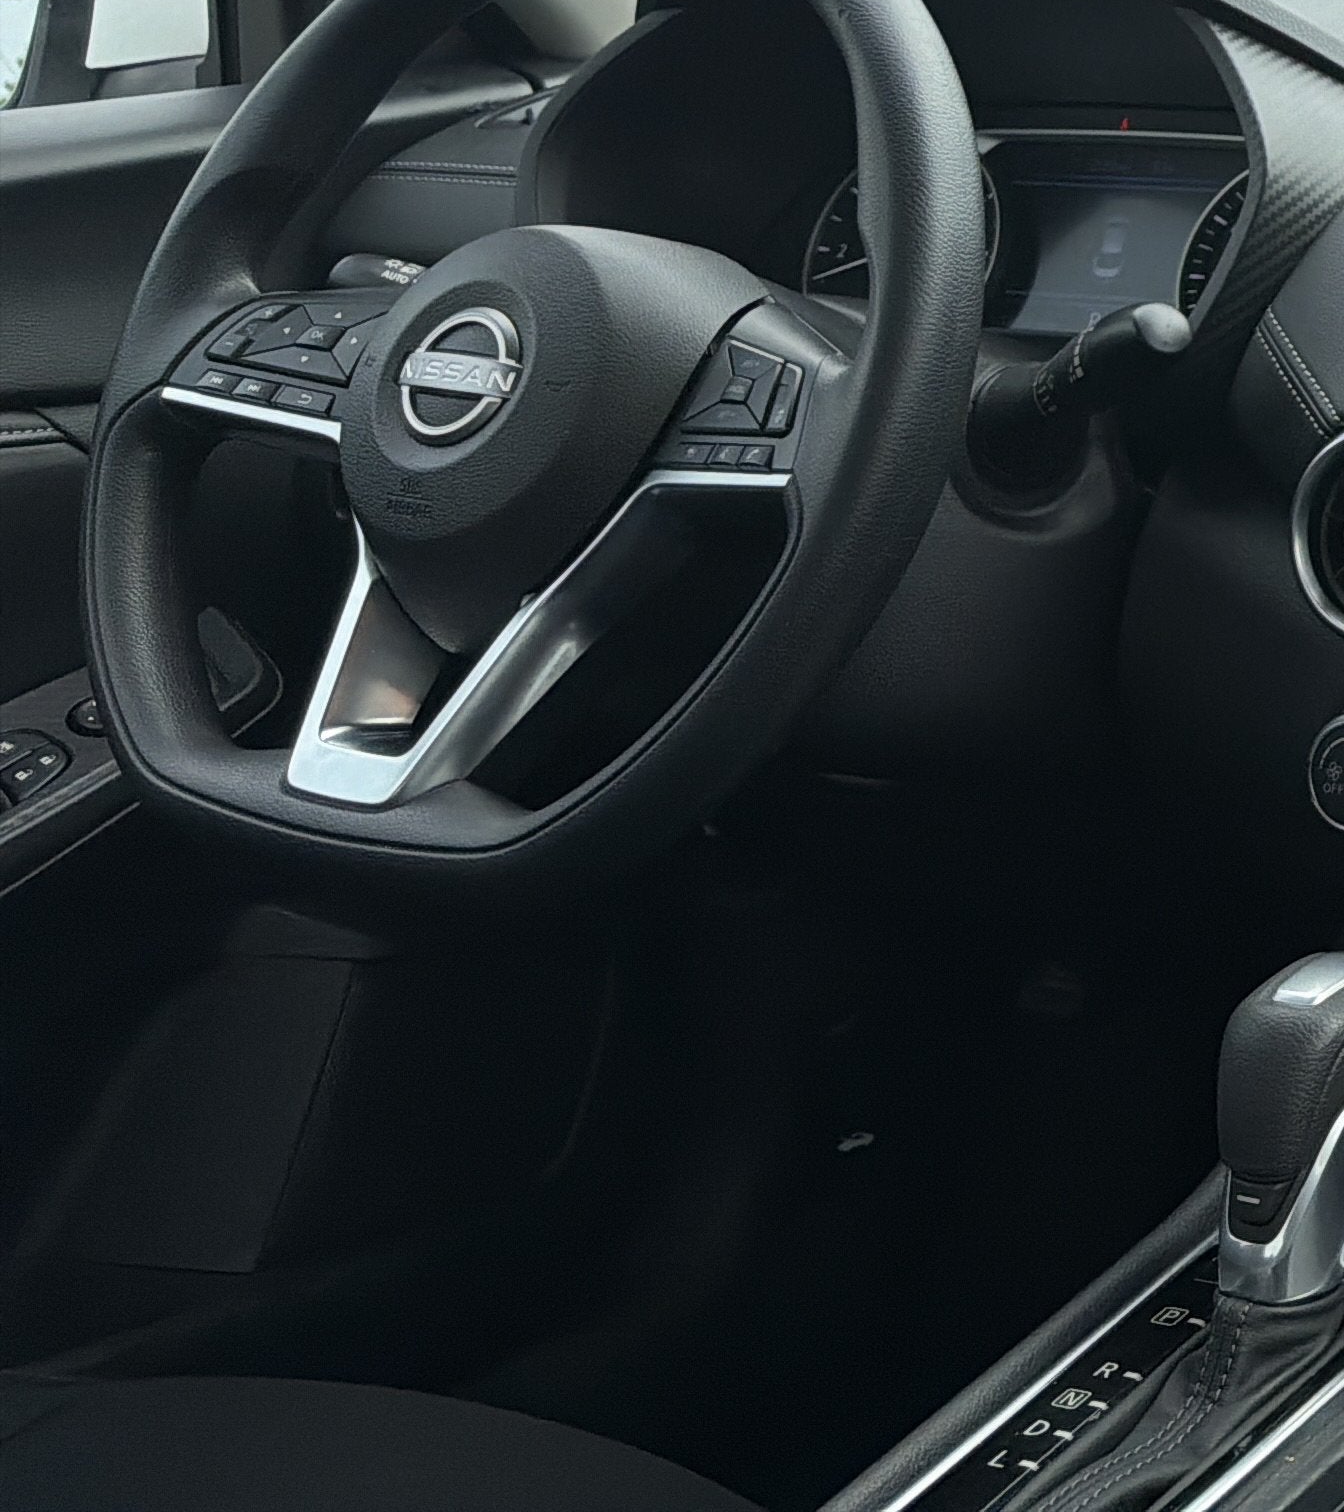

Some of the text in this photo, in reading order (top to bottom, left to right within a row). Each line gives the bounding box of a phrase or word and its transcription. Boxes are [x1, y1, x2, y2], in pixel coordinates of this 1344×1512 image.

[381, 269, 410, 285] AUTO
[401, 352, 517, 393] NISSAN
[1323, 783, 1343, 794] OFF
[1093, 1361, 1119, 1379] R
[1023, 1419, 1050, 1436] D
[987, 1449, 1008, 1469] L
